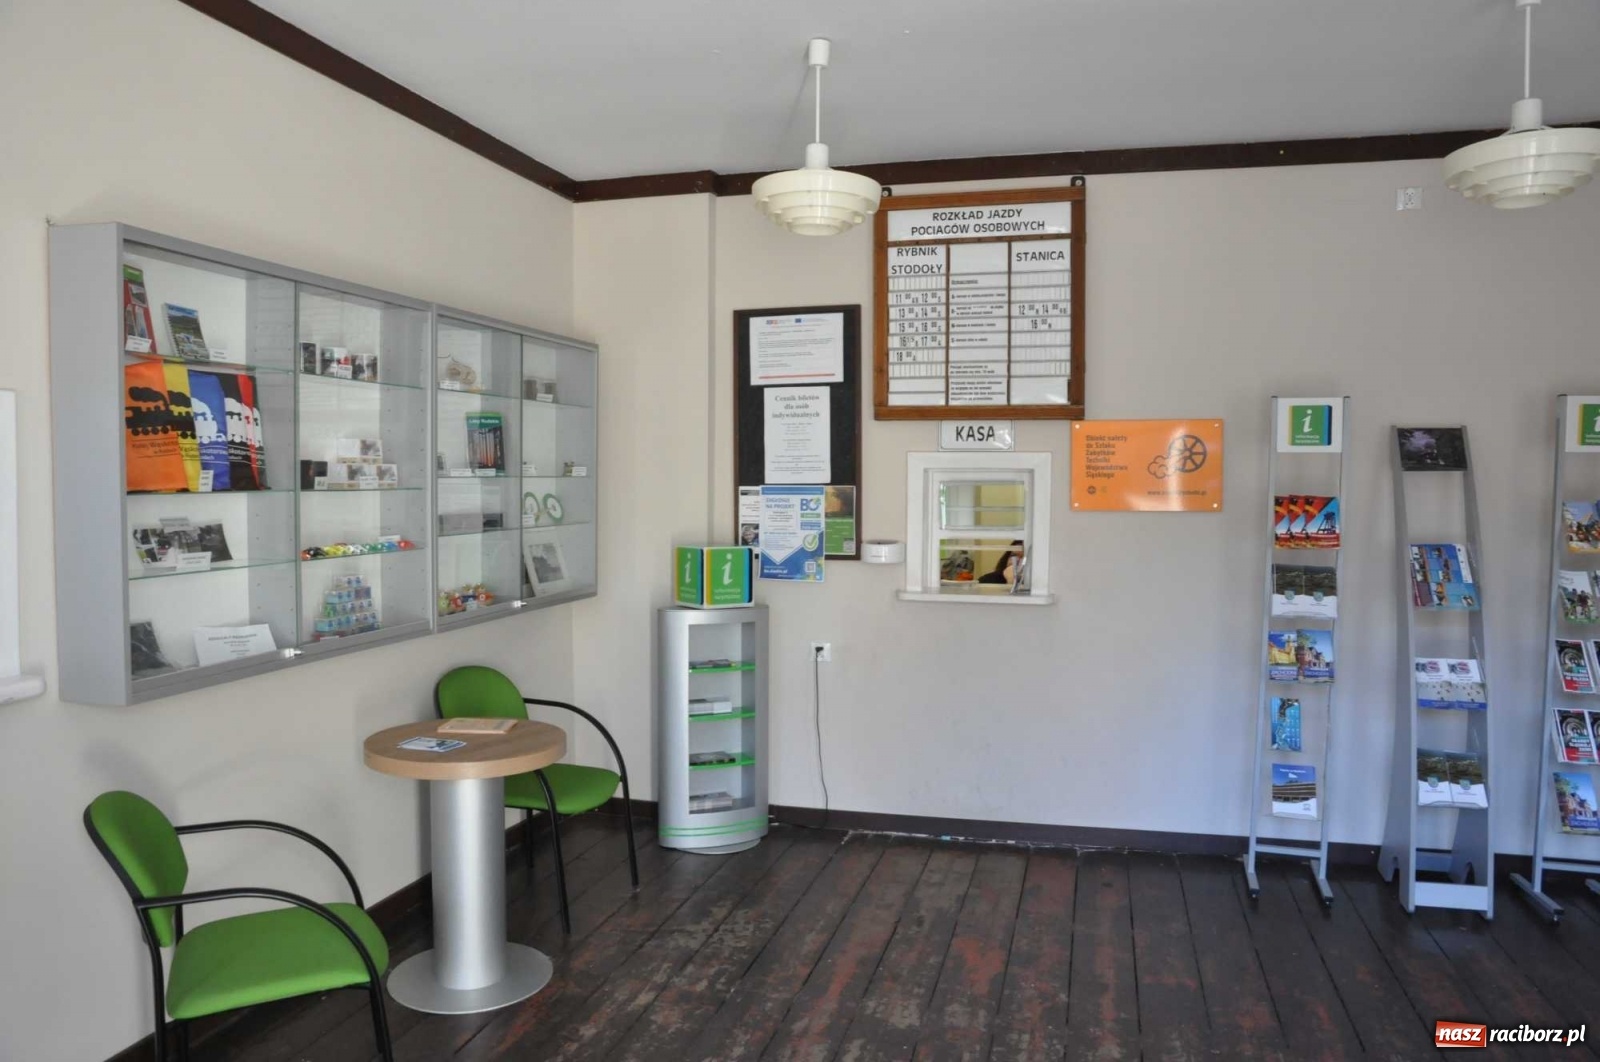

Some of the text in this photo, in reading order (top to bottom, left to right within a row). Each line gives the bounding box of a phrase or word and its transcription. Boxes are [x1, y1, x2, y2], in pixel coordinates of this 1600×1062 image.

[932, 208, 1023, 222] ROZKŁAD JAZDY
[973, 221, 1045, 234] OSOBOWYCH
[896, 246, 938, 257] RYBNIK
[1016, 250, 1065, 262] STANICA
[891, 263, 943, 275] STODOŁY
[955, 425, 996, 442] KASA
